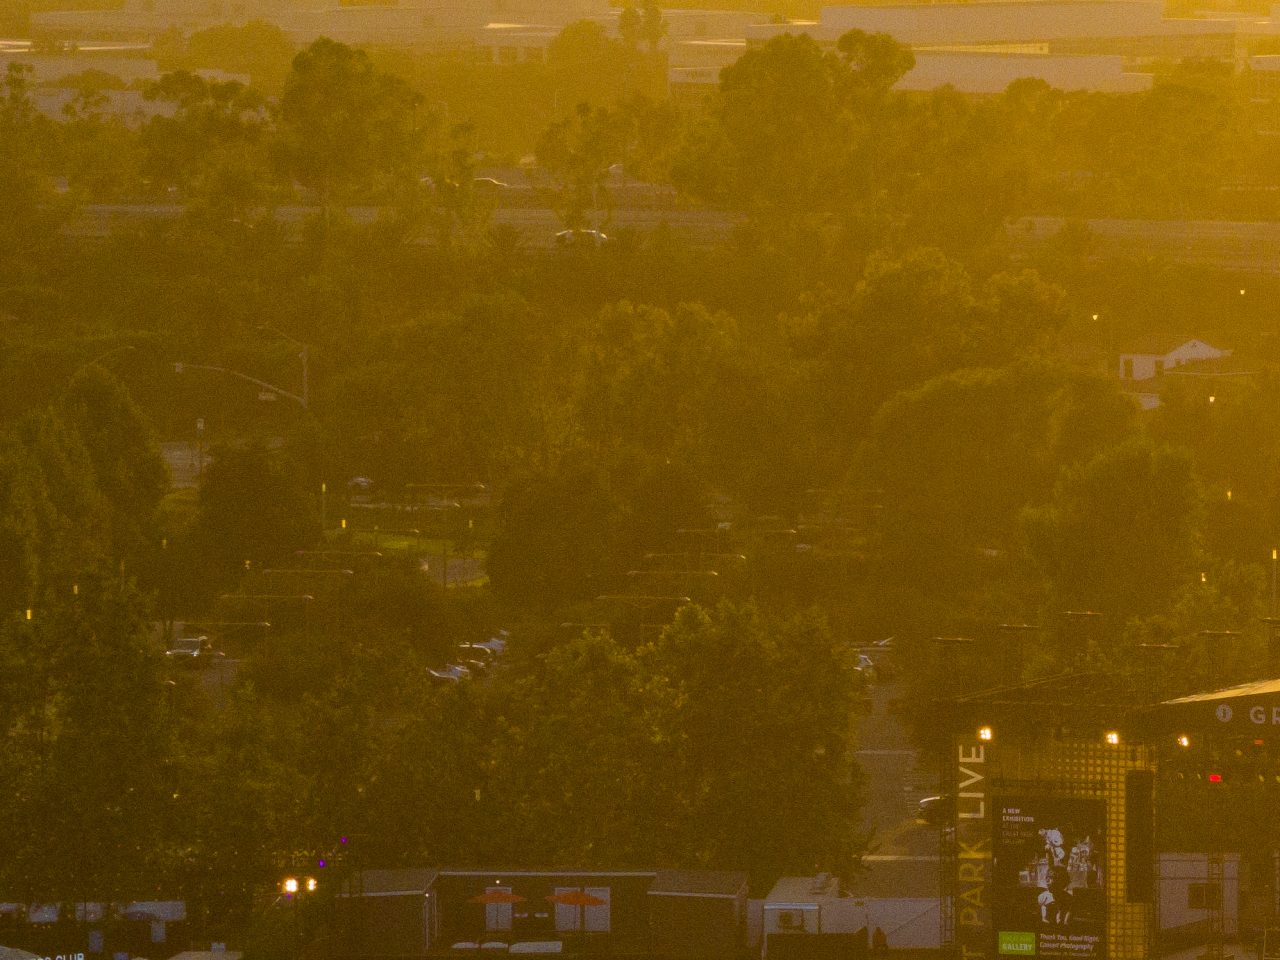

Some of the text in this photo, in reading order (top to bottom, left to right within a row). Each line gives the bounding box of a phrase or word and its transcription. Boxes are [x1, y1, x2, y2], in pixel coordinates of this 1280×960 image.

[958, 744, 985, 818] LIVE
[958, 838, 992, 926] PARK
[1002, 943, 1033, 951] GALLERY
